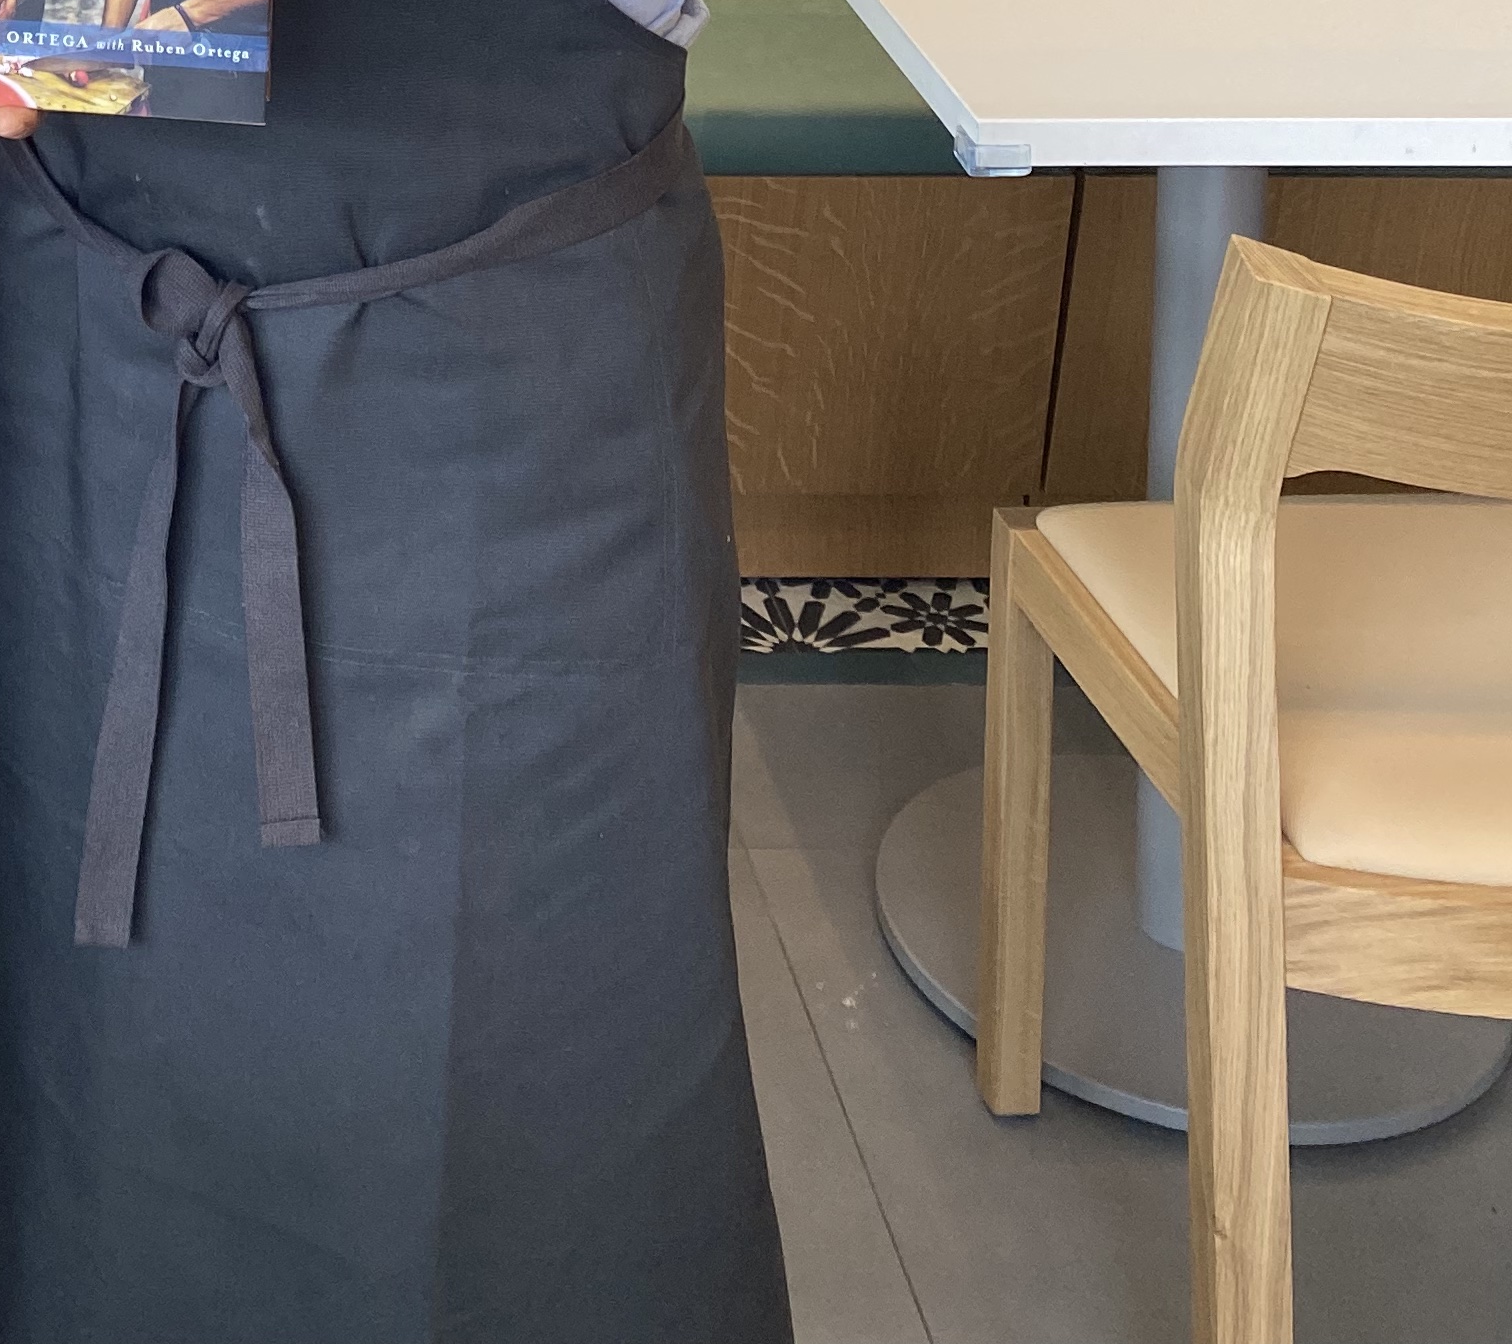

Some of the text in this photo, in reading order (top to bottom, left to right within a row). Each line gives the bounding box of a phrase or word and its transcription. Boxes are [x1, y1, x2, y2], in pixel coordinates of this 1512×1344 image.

[6, 30, 89, 49] ORTEGA
[96, 39, 125, 51] with
[131, 39, 186, 55] Ruben
[192, 43, 250, 63] Ortega
